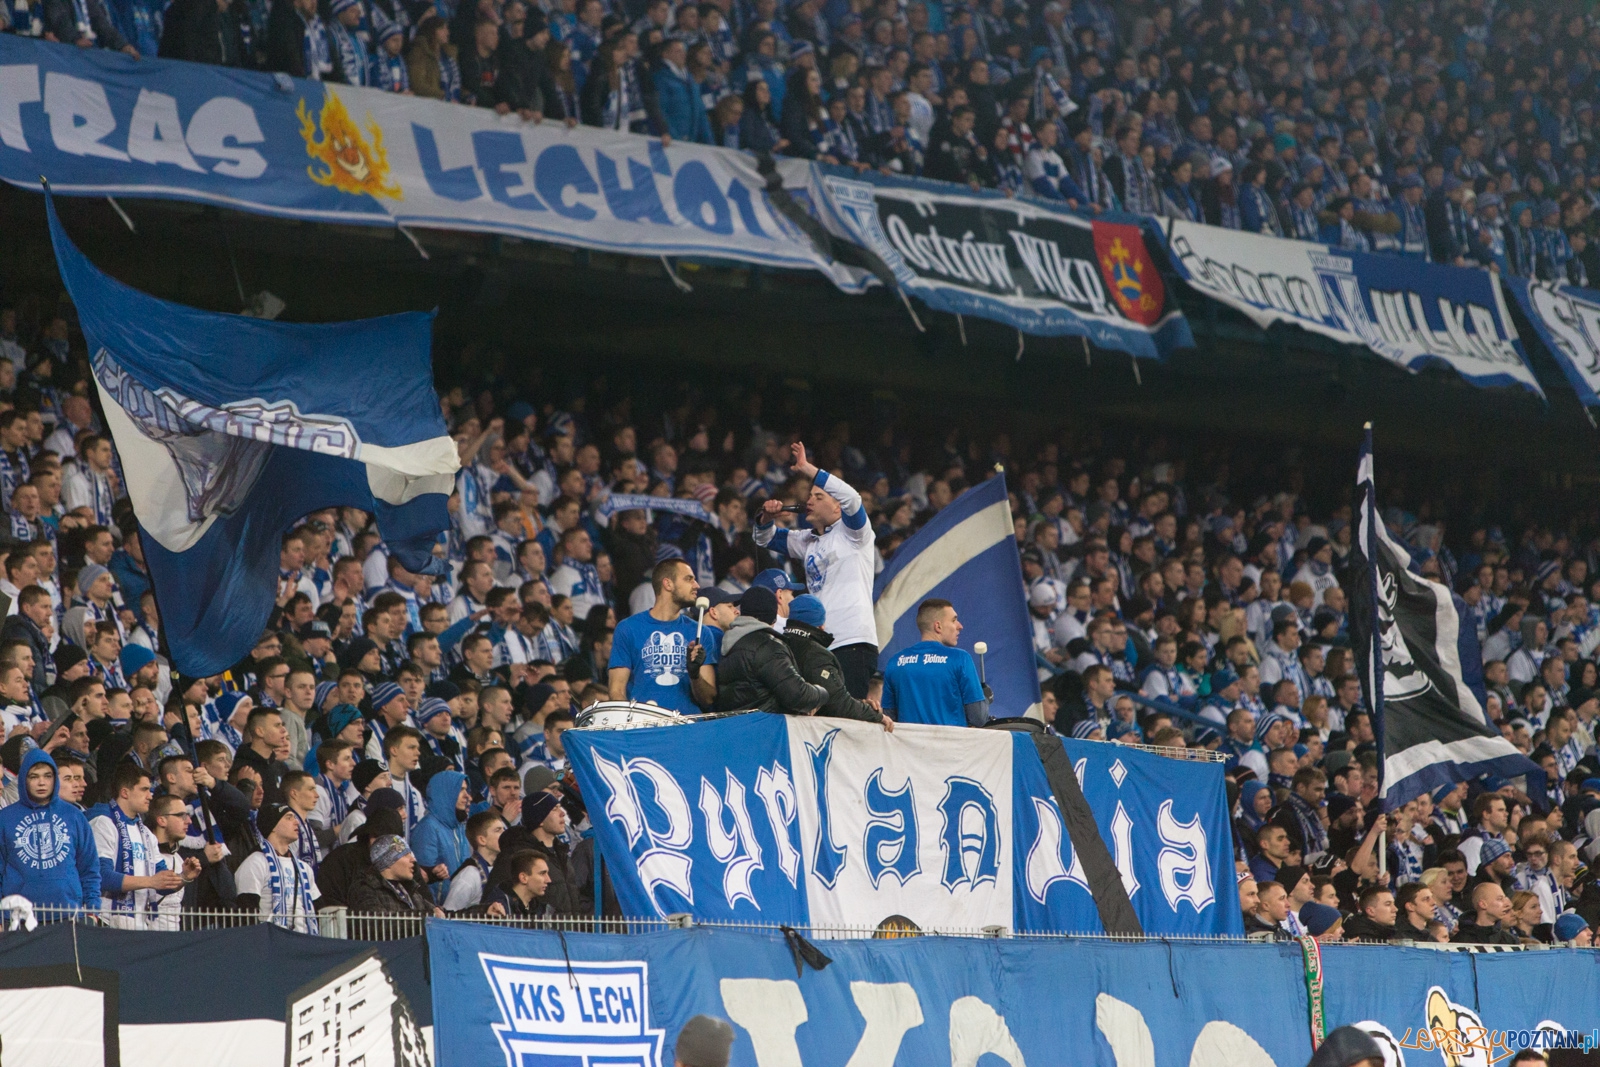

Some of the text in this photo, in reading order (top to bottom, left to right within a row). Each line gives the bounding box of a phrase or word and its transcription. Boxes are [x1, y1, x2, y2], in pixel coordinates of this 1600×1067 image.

[887, 214, 1015, 289] Ostrów
[671, 646, 688, 656] JOR
[653, 654, 681, 666] 2015
[17, 849, 31, 864] NIE
[510, 982, 638, 1024] KKS LECH
